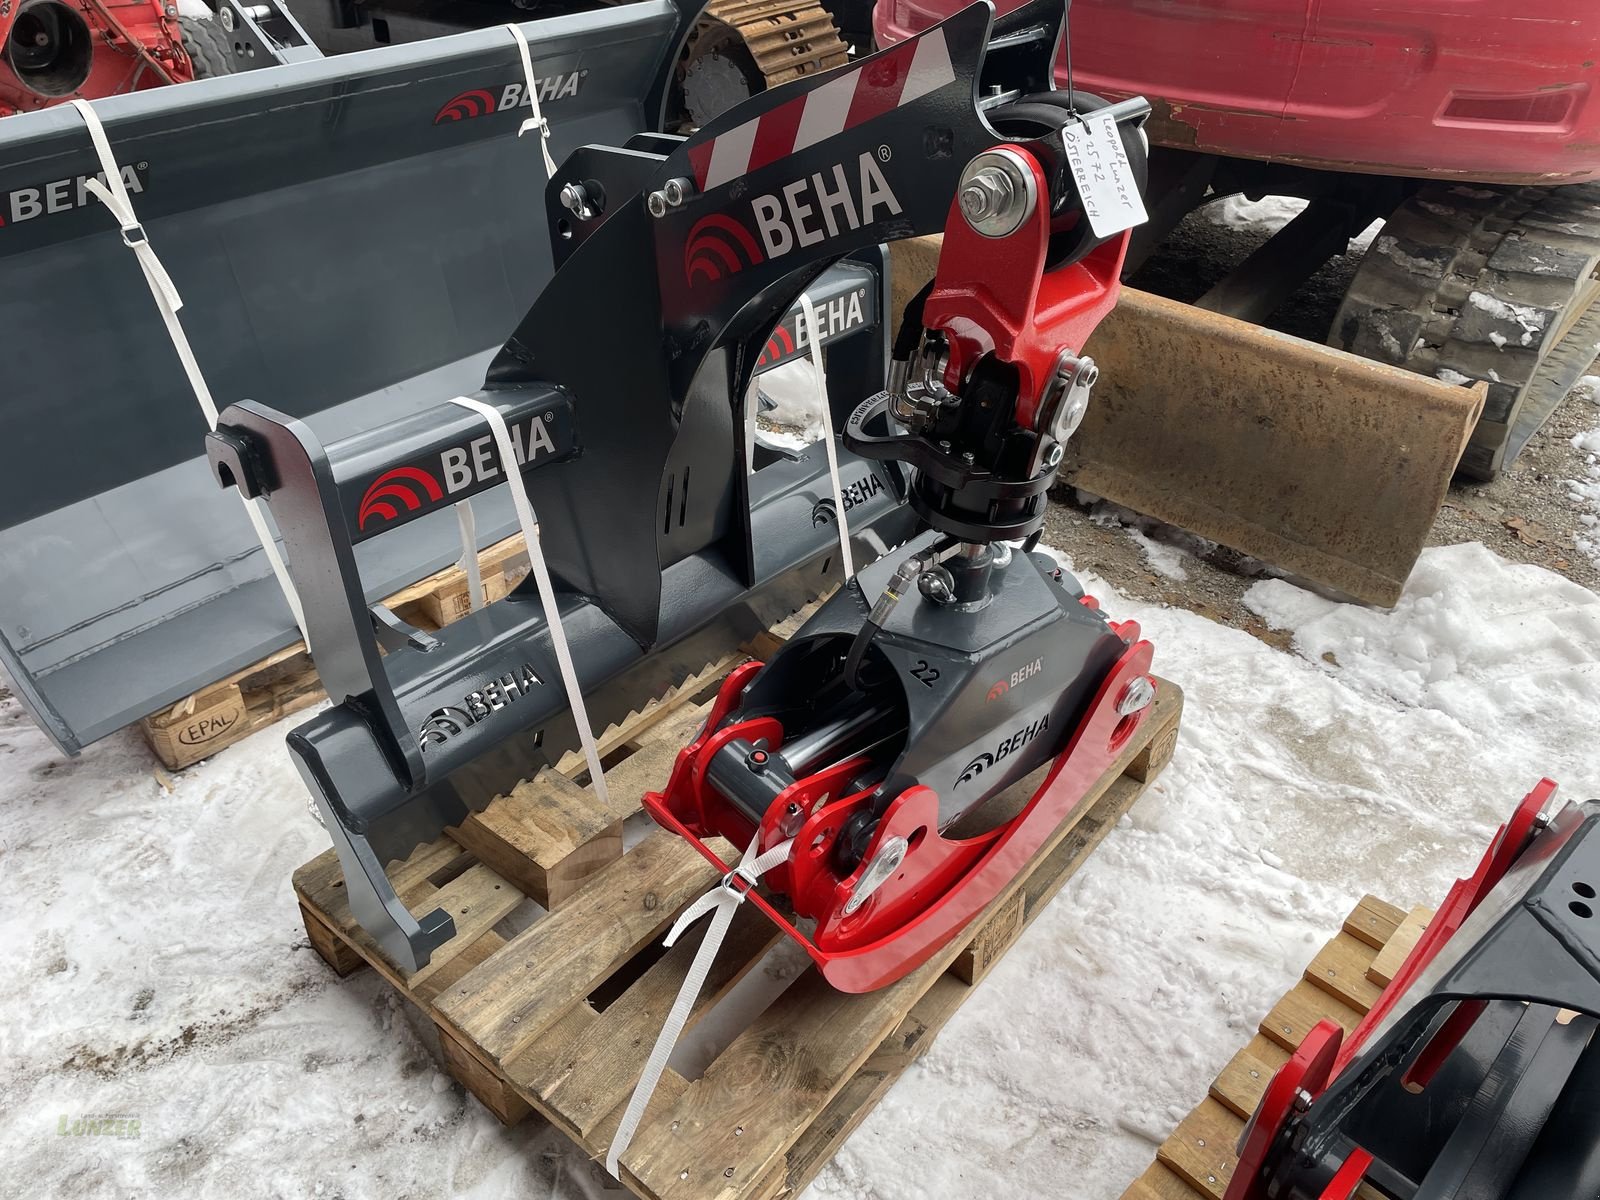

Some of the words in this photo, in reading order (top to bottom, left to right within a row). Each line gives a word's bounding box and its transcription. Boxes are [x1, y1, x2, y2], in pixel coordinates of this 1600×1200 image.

[1065, 131, 1100, 217] ÖSTERREICH
[1086, 141, 1106, 182] 2572
[1109, 162, 1133, 209] Lunzer
[464, 662, 545, 723] BEHA
[909, 659, 940, 688] 22
[1010, 659, 1043, 688] BEHA
[187, 714, 232, 742] EPAL
[994, 713, 1050, 763] BEHA
